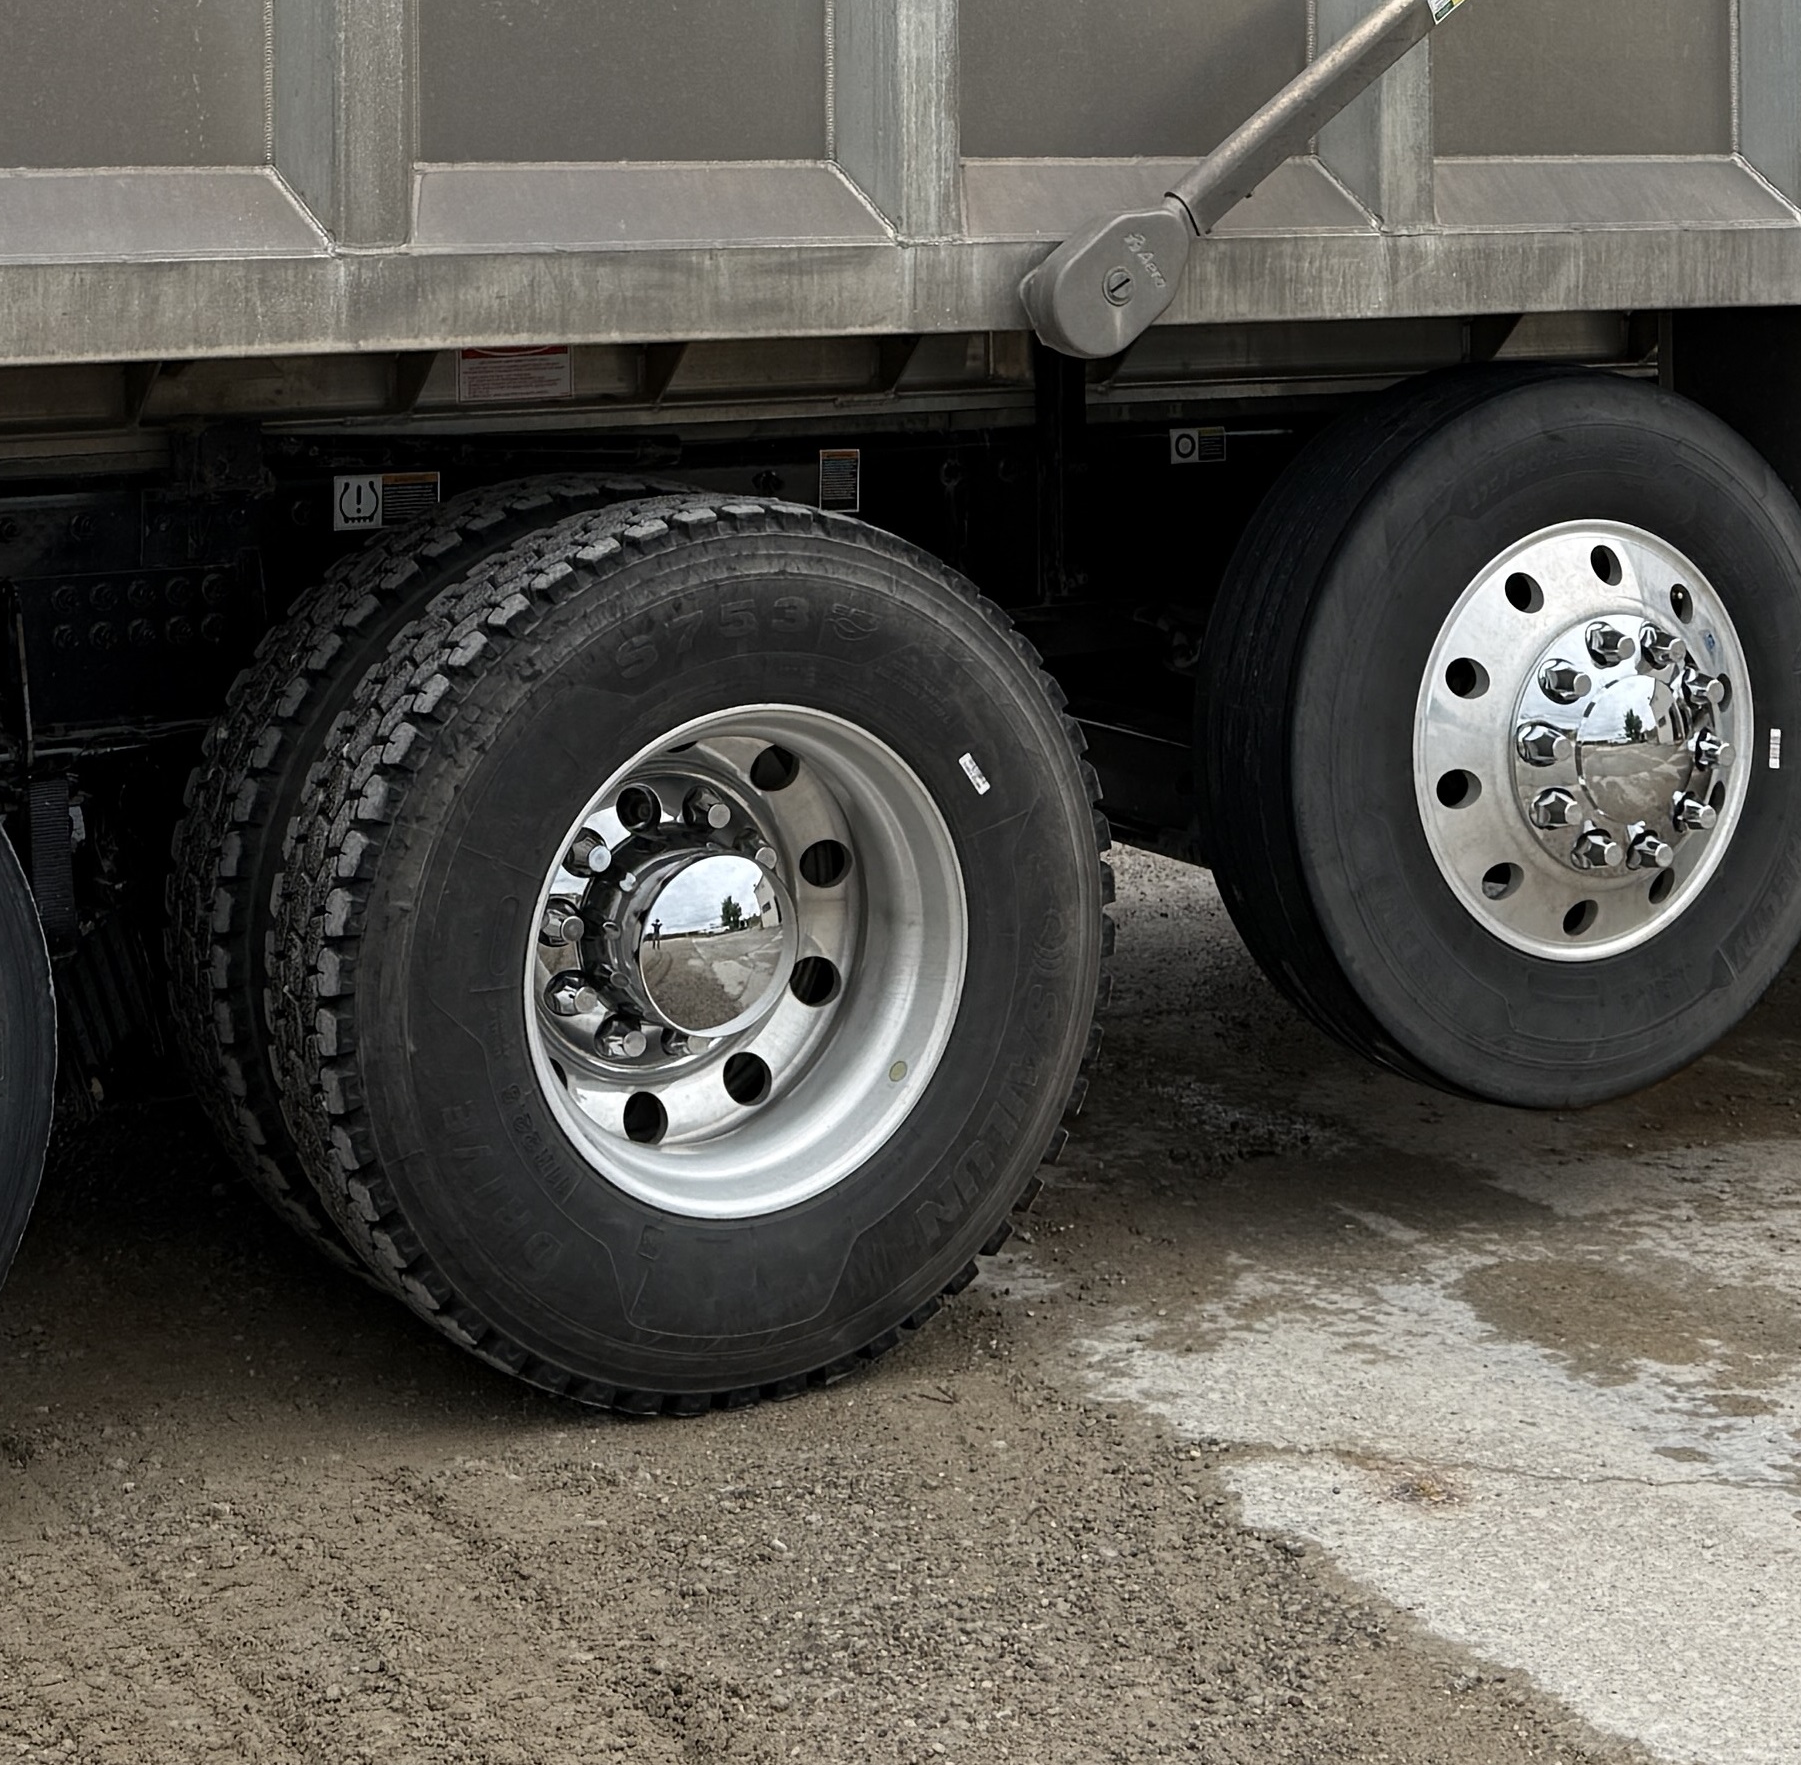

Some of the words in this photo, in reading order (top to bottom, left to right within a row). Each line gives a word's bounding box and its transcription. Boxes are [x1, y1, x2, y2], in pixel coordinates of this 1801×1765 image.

[1138, 251, 1167, 289] Aero
[616, 595, 810, 680] S753
[916, 983, 1060, 1244] SAILUN
